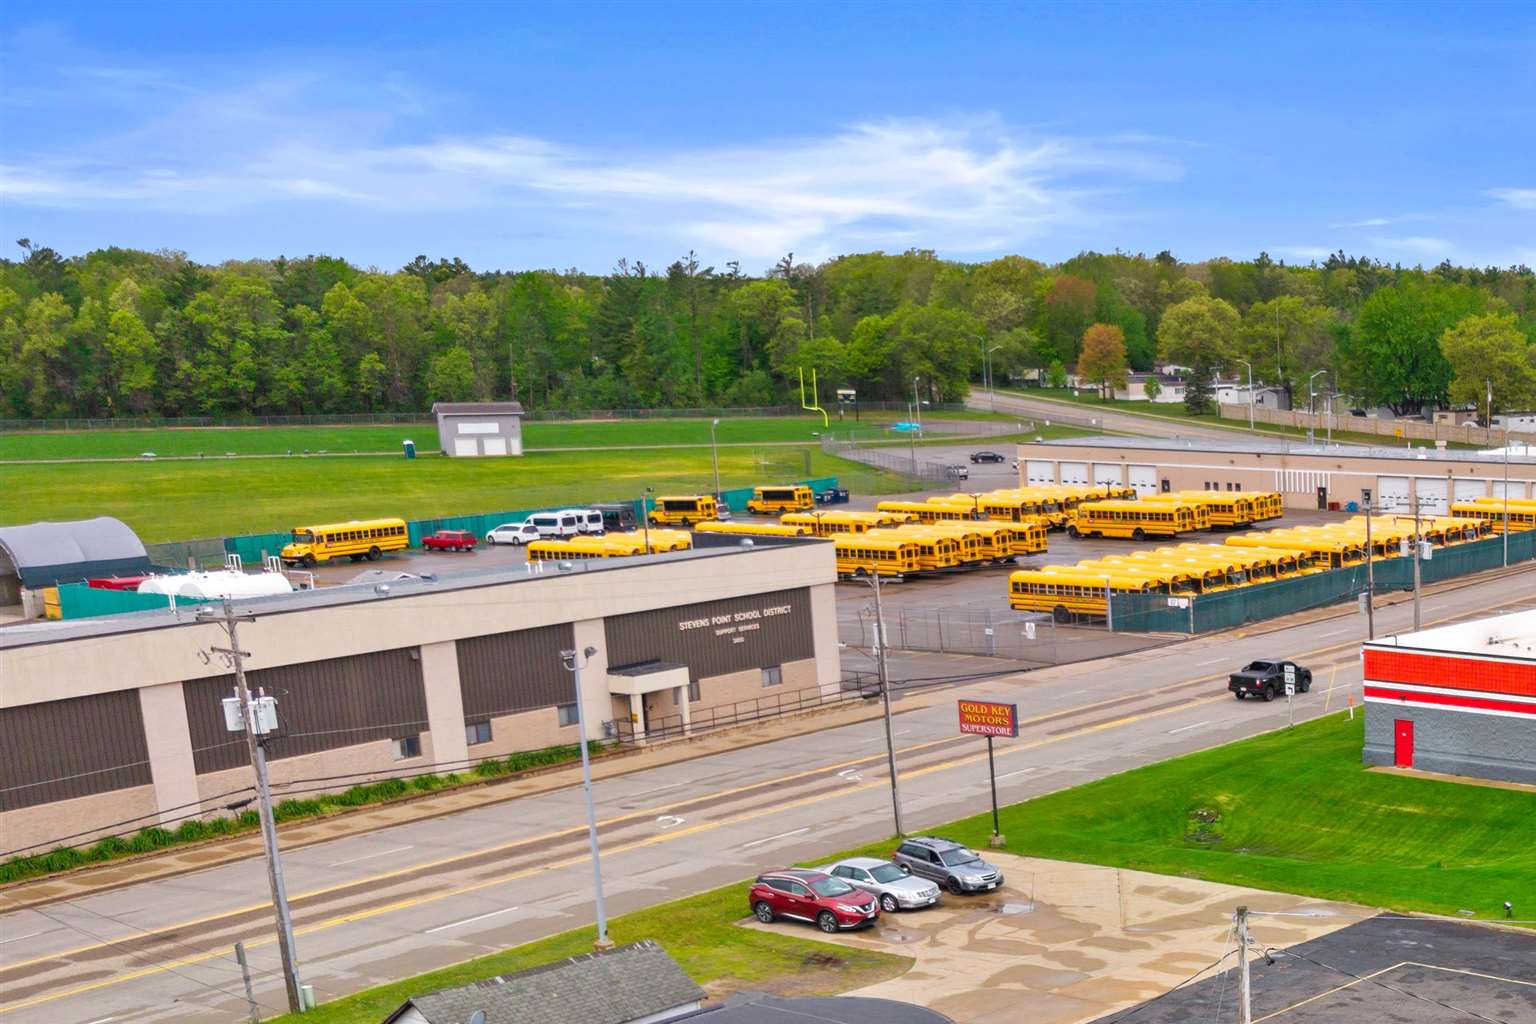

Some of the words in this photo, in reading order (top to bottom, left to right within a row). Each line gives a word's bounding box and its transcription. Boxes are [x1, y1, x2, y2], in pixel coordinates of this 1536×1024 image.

[679, 619, 709, 630] STEVENS
[711, 615, 731, 625] POINT
[734, 610, 761, 622] SCHOOL
[763, 605, 791, 617] DISTRICT
[960, 703, 988, 714] GOLD
[991, 706, 1010, 716] KEY
[965, 714, 1009, 725] MOTORS
[961, 723, 1012, 736] SUPERSTORE
